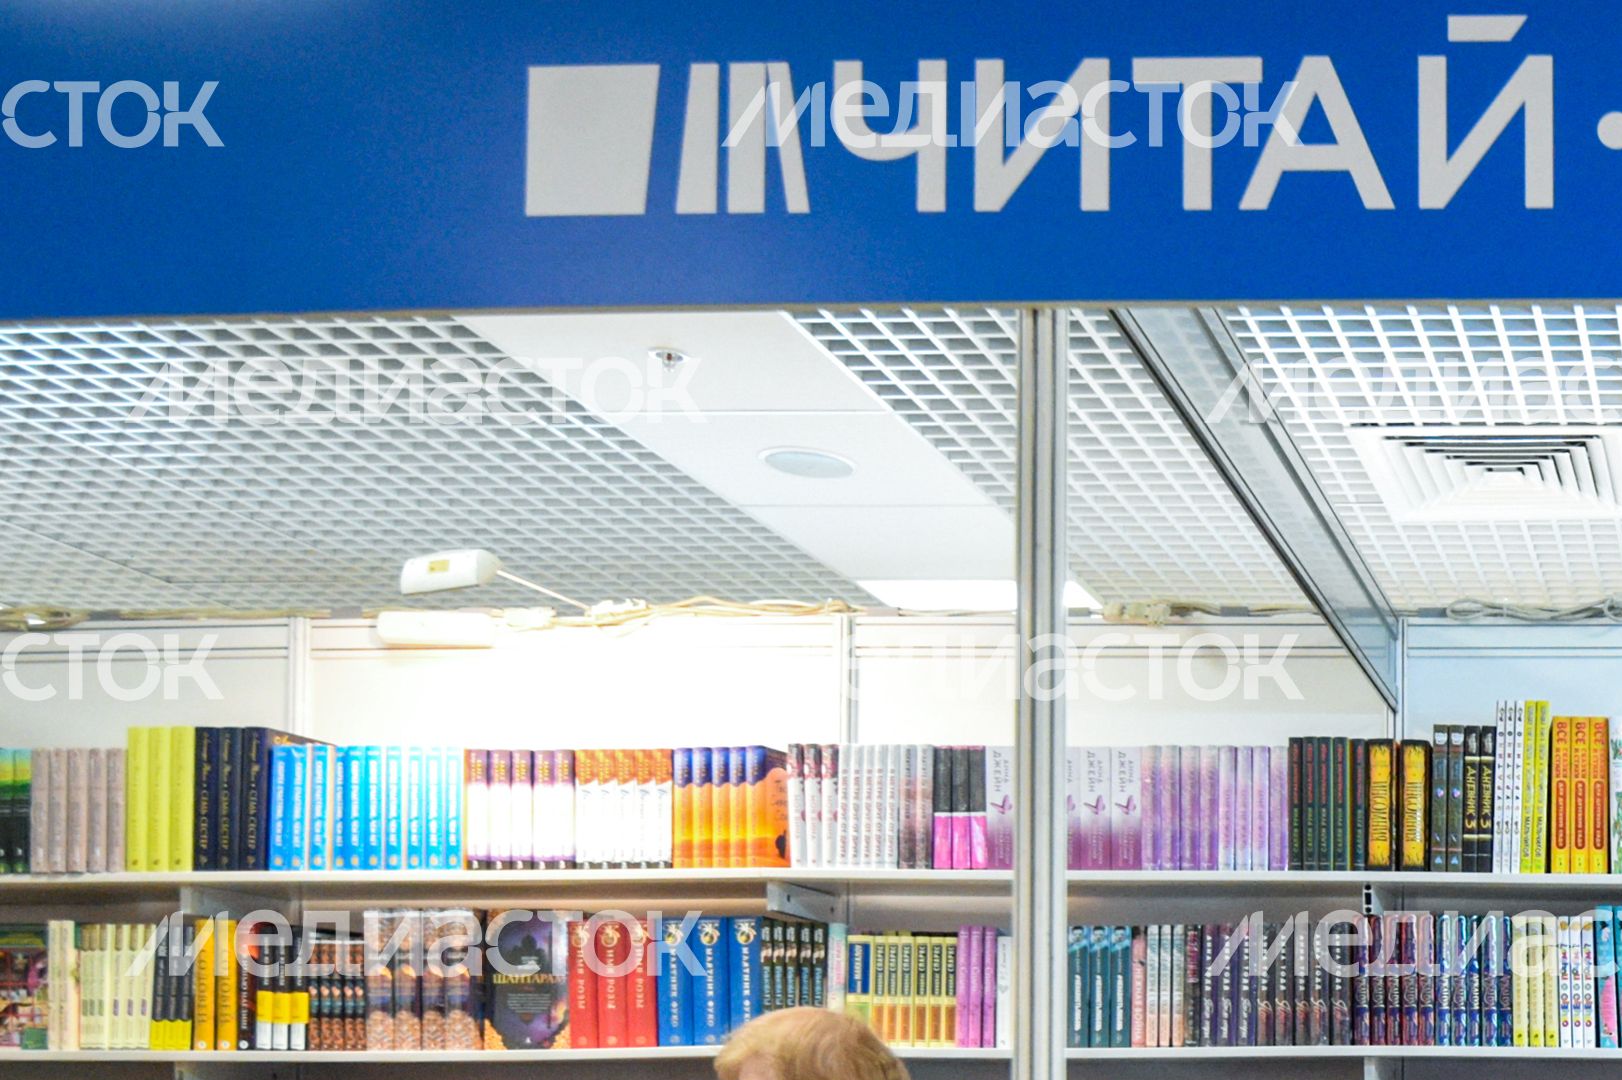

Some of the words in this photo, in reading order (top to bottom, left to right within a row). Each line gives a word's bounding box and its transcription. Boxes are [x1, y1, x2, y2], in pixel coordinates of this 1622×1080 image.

[1554, 721, 1566, 745] ВСЕ
[1574, 721, 1585, 745] ВСЕ
[1593, 721, 1604, 745] ВСЕ
[1466, 766, 1476, 817] ДНЕВНИК
[1481, 766, 1491, 817] ДНЕВНИК
[1466, 818, 1476, 830] 3
[1481, 818, 1491, 830] 3
